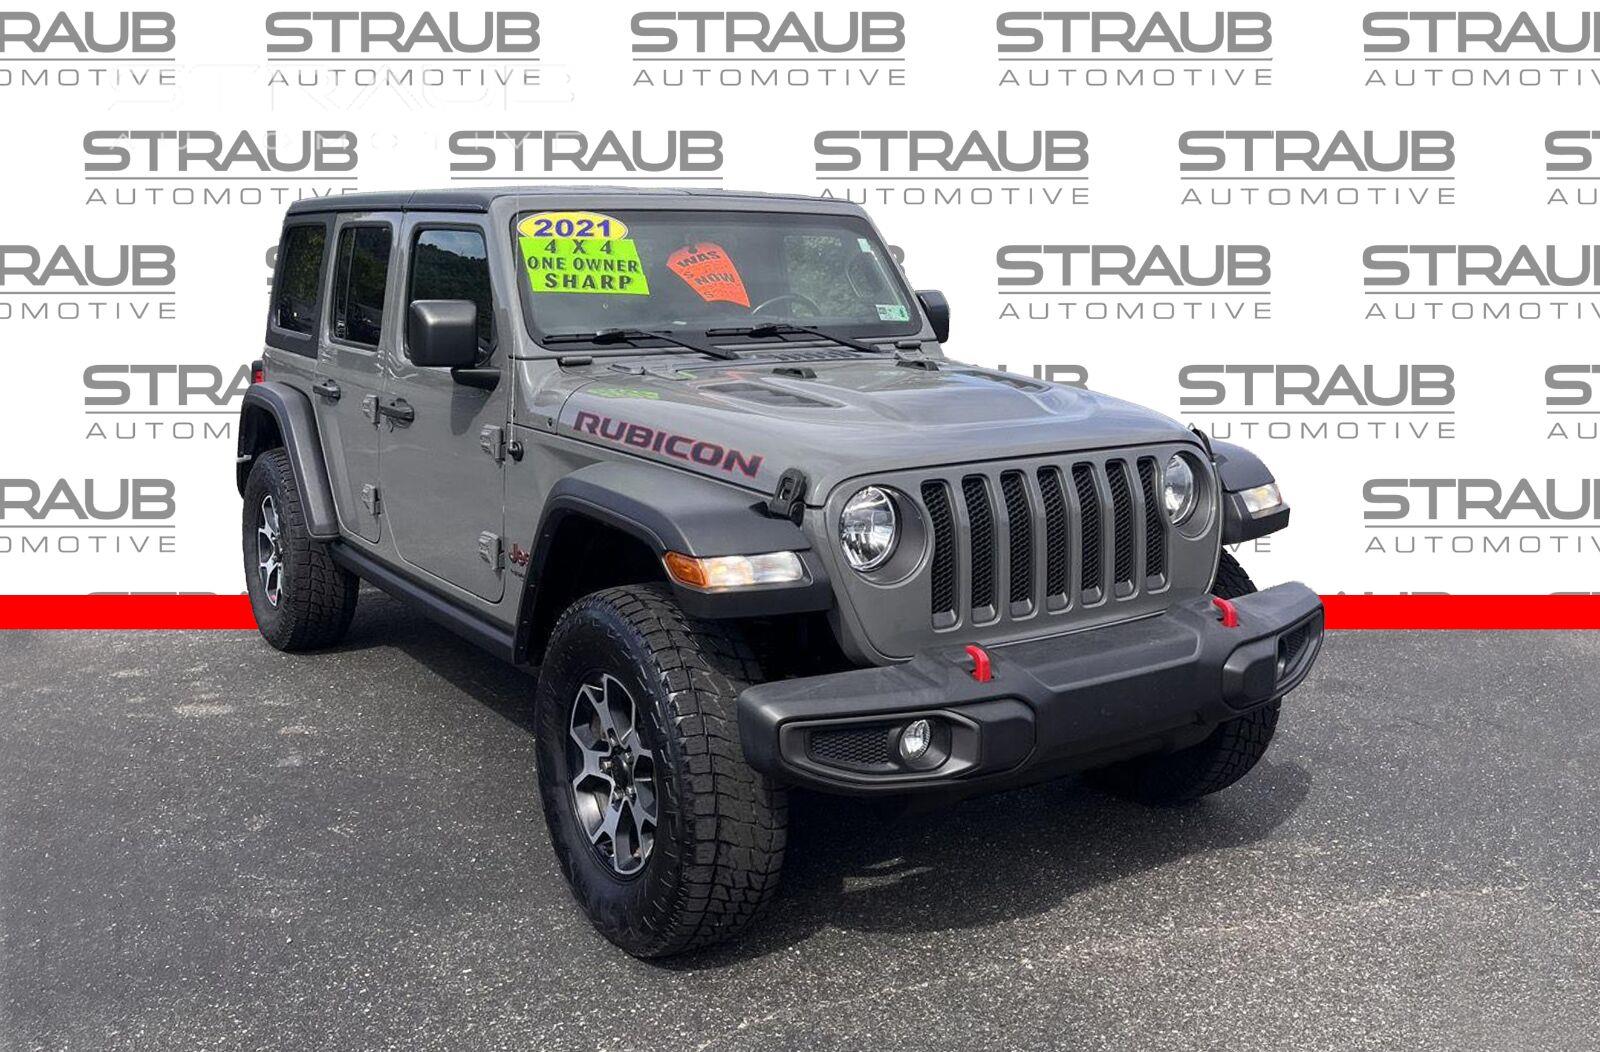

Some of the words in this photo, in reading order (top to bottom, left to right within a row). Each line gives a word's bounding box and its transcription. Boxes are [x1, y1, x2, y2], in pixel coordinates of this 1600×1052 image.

[534, 219, 612, 237] 2021
[544, 239, 557, 254] 4
[572, 240, 587, 254] X
[599, 240, 612, 254] 4
[527, 256, 565, 271] ONE
[573, 257, 638, 273] OWNER
[677, 250, 721, 268] WAS
[544, 273, 632, 290] SHARP
[694, 272, 735, 286] NOW
[572, 410, 764, 479] RUBICON
